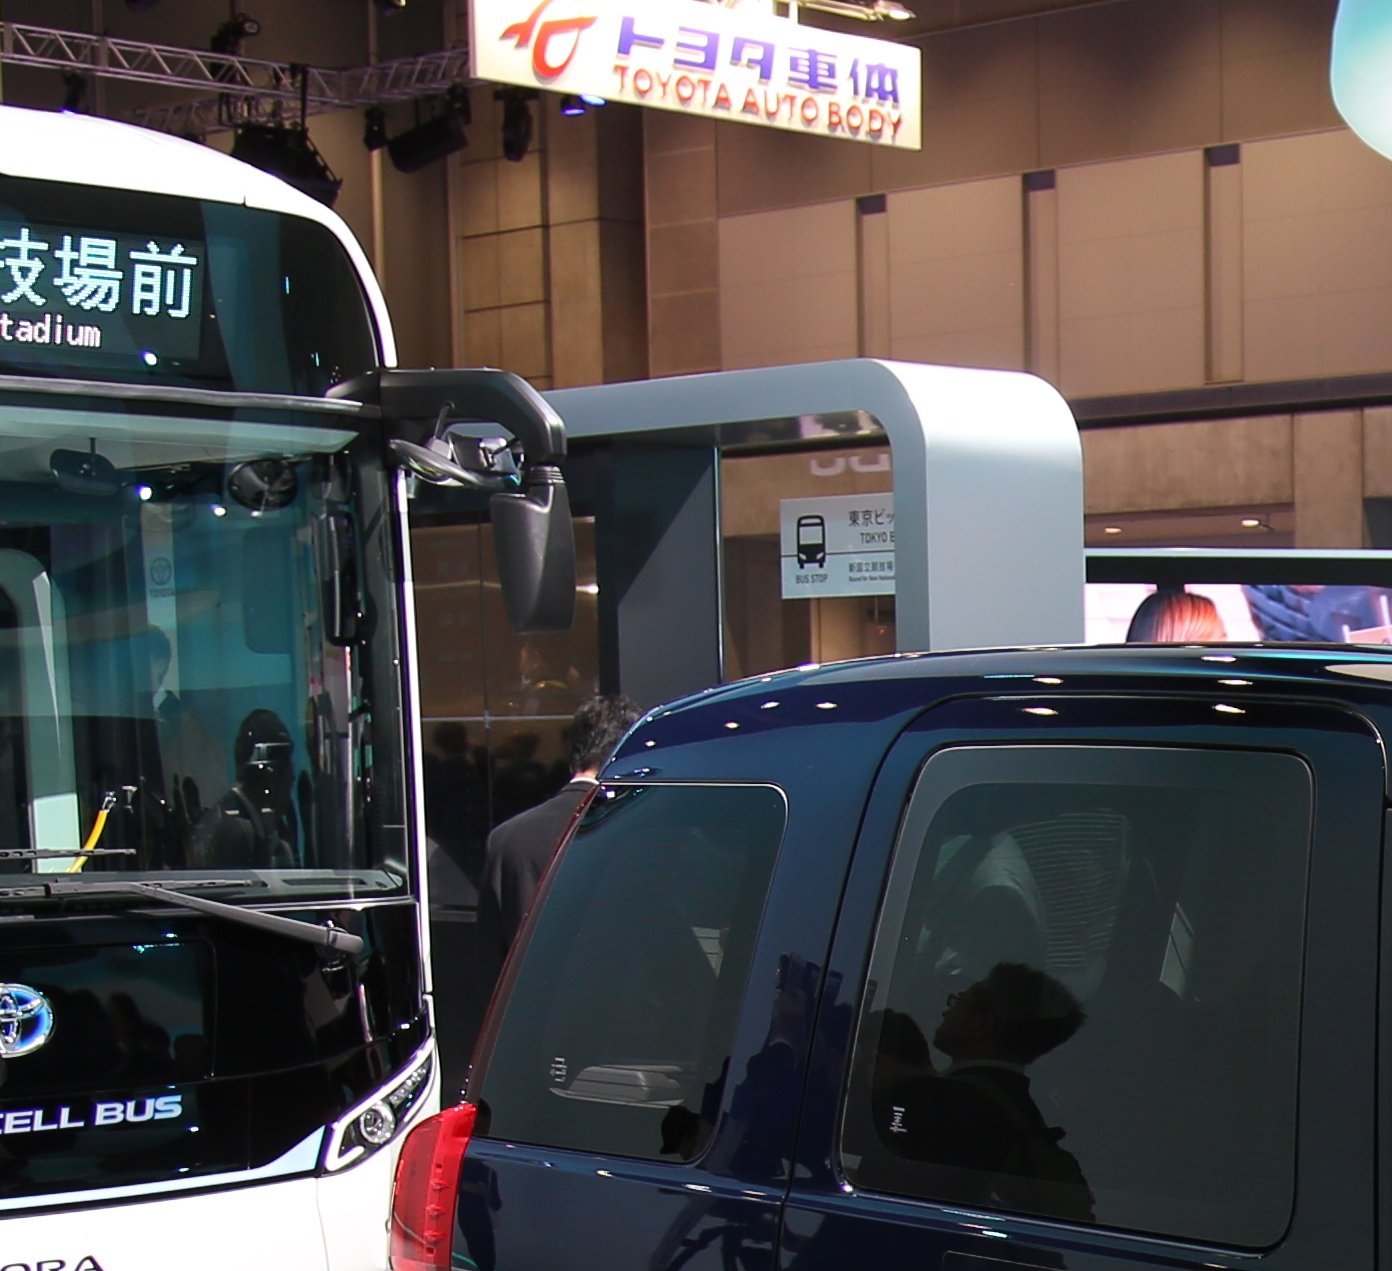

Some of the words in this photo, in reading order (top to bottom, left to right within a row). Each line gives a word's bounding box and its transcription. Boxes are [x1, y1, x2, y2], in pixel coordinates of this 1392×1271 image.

[616, 16, 900, 106] トヨタ車体
[612, 64, 731, 111] TOYOTA
[742, 87, 818, 126] AUTO
[827, 101, 902, 141] BODY
[860, 531, 888, 544] TOKYO
[795, 574, 809, 584] BUS
[811, 573, 828, 584] STOP
[0, 1106, 84, 1135] ELL
[95, 1095, 182, 1126] BUS
